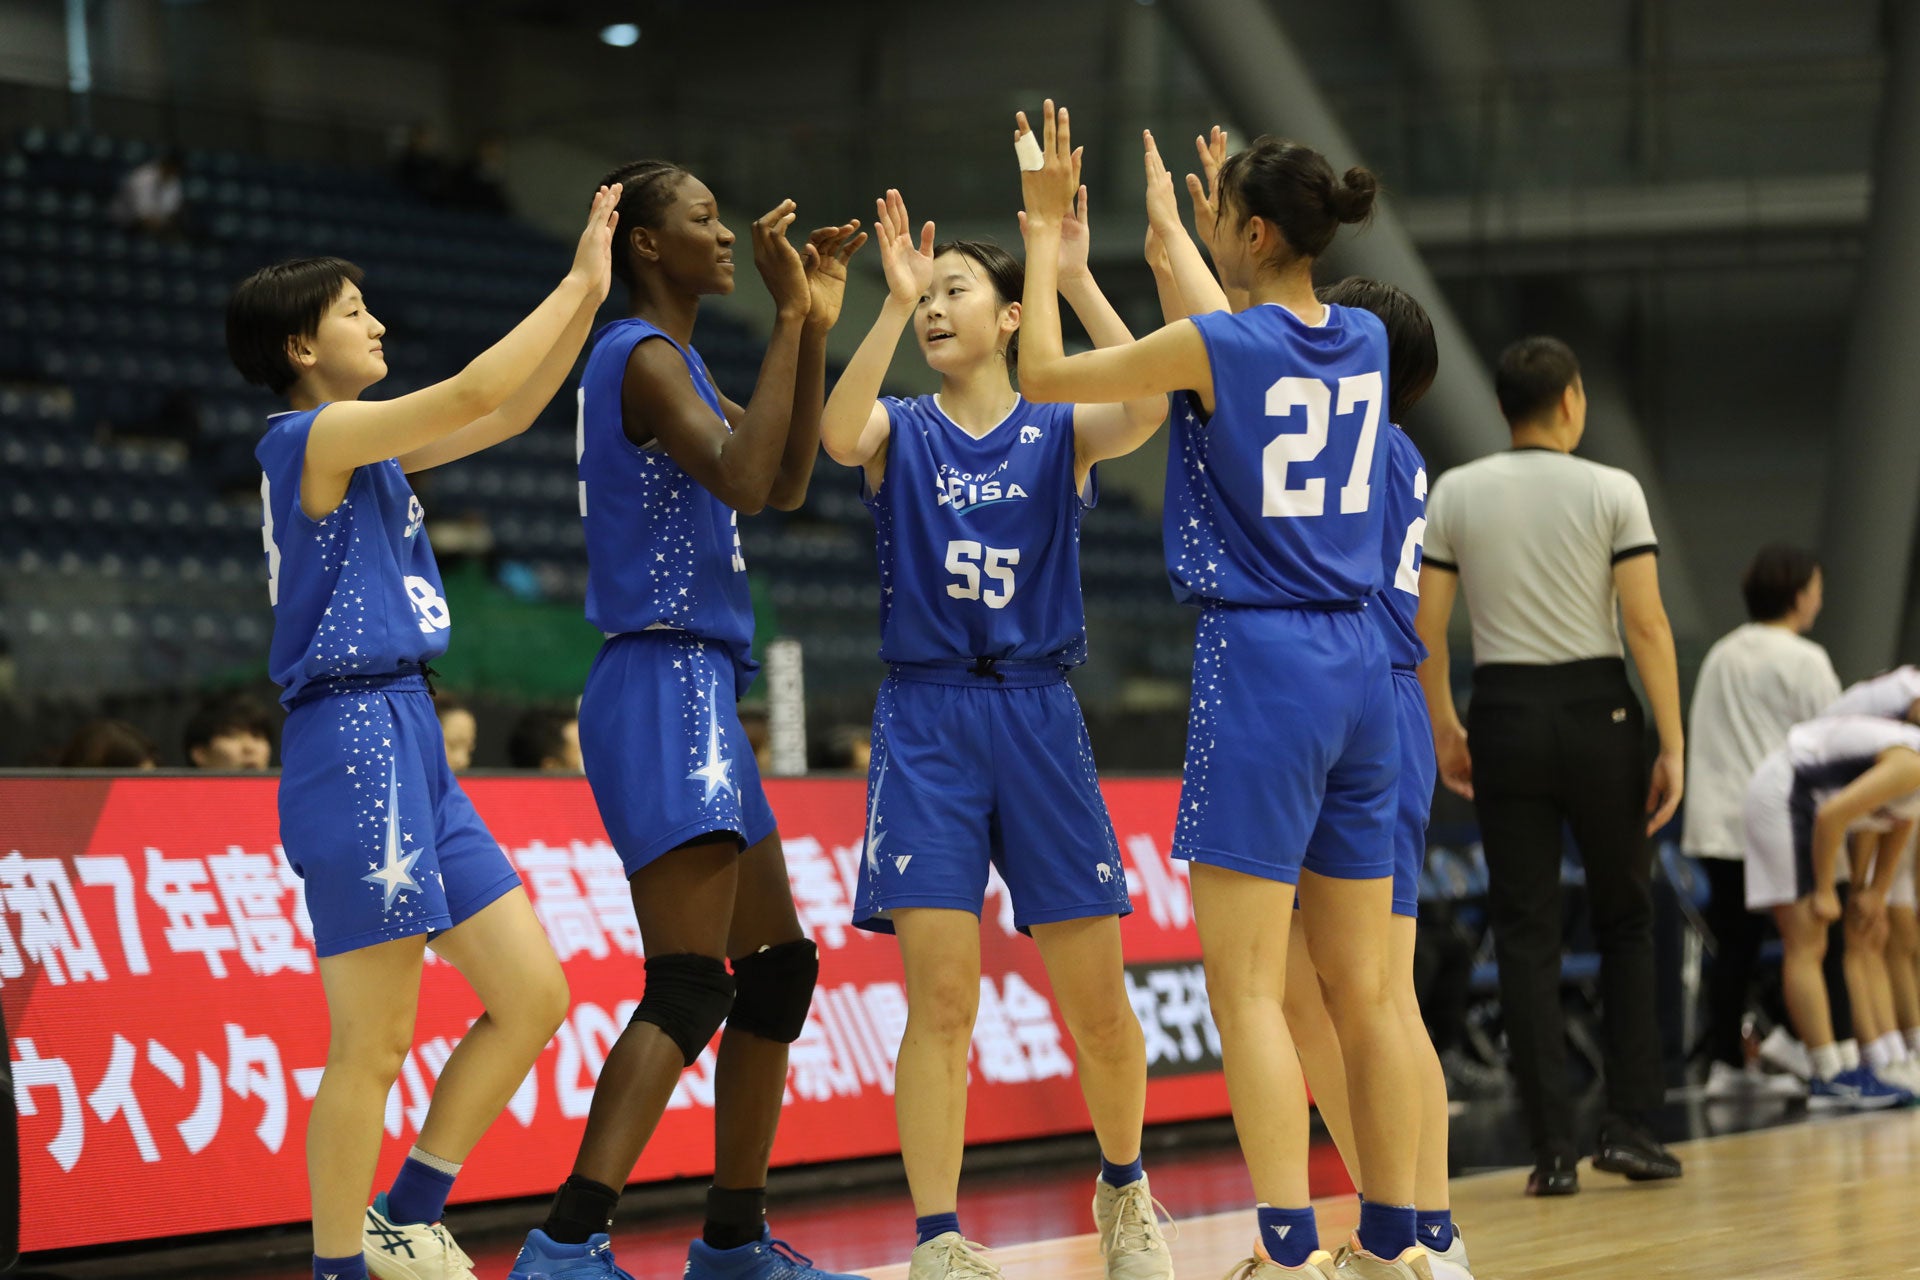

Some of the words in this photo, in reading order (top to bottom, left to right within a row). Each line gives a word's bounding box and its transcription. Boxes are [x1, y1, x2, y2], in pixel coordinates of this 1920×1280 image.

[935, 472, 1029, 510] SEISA
[1261, 370, 1383, 518] 27
[944, 540, 1020, 609] 55
[0, 844, 316, 988] 和7年度
